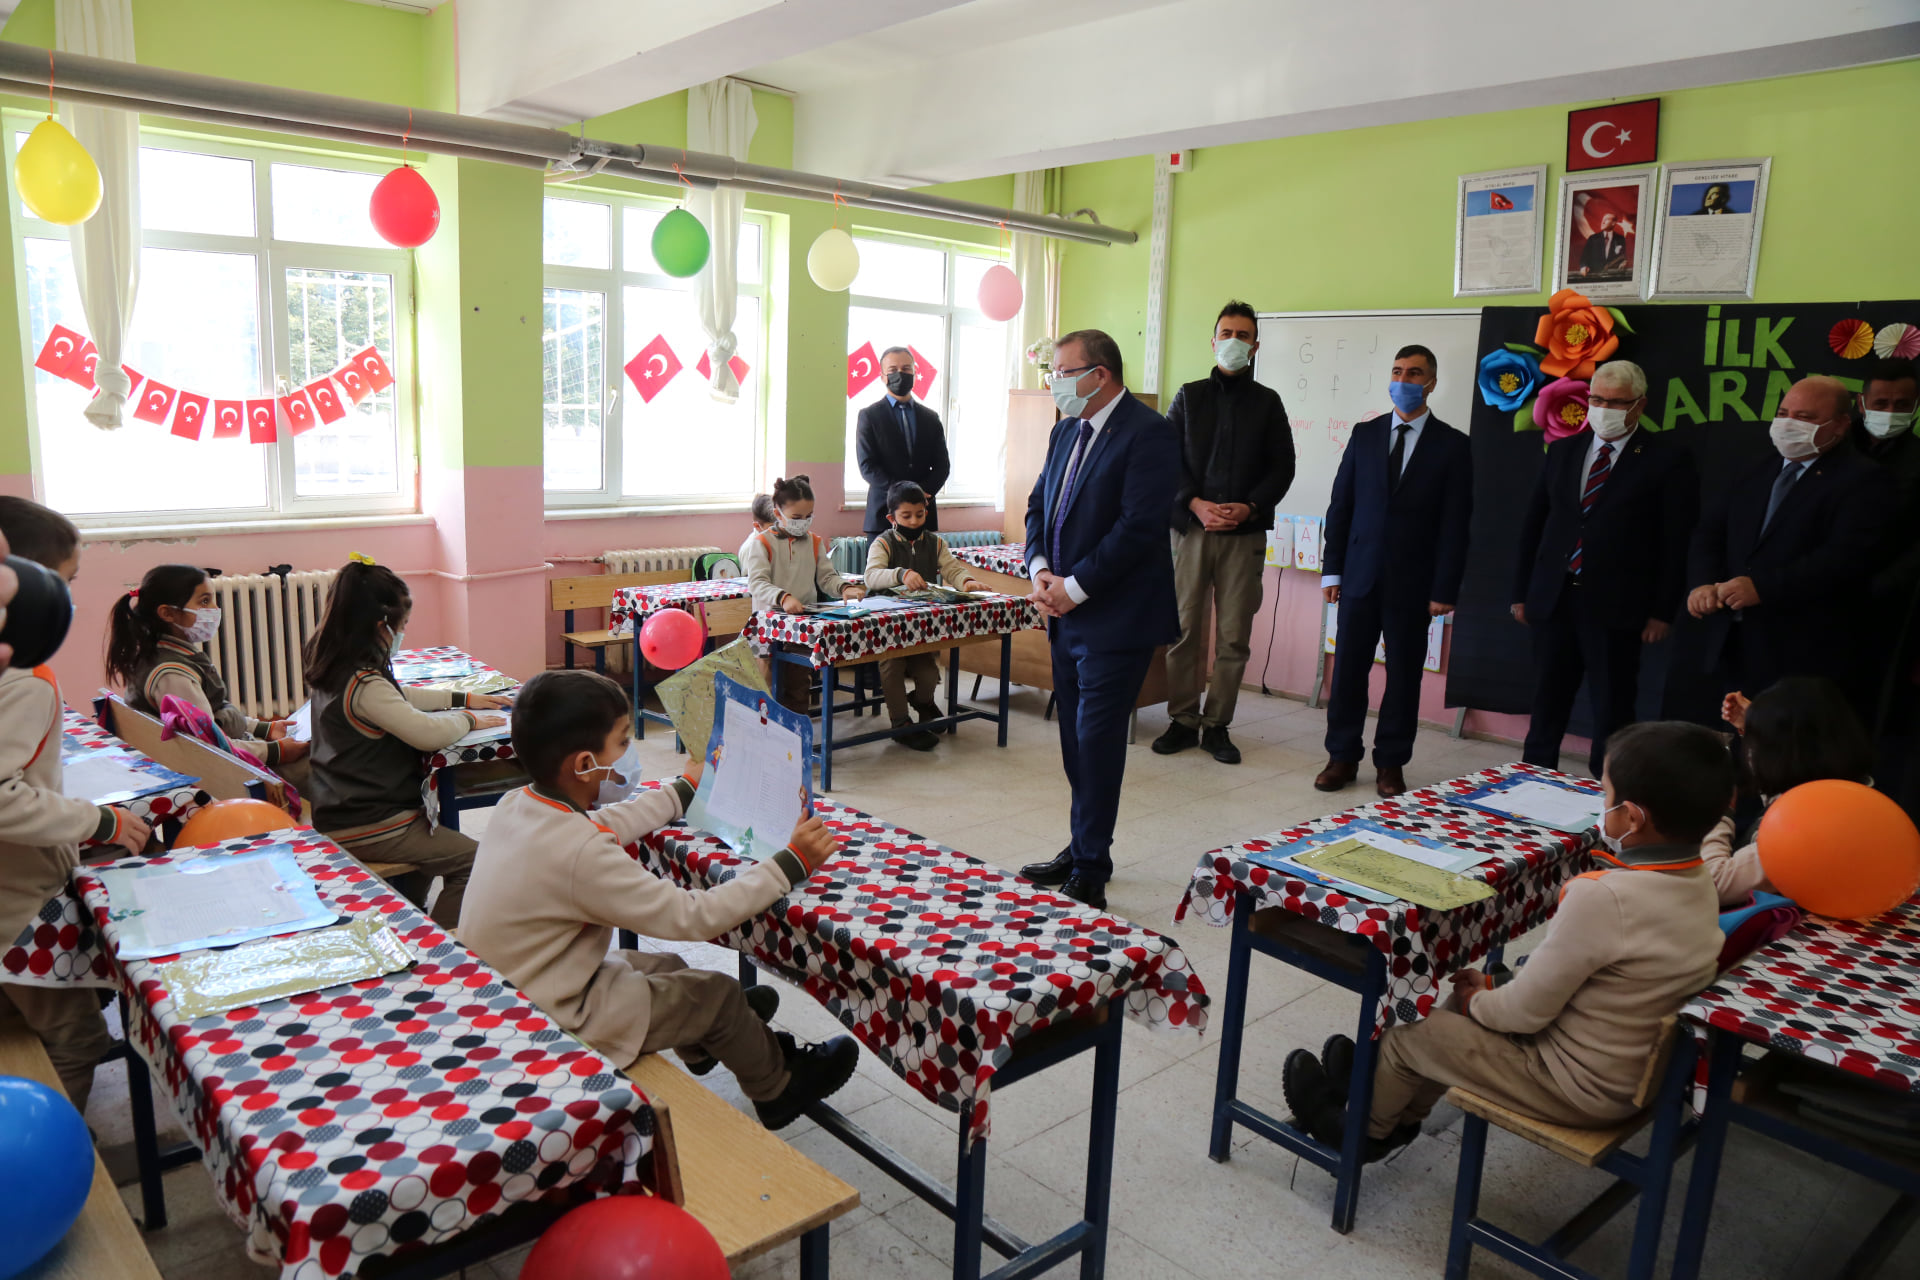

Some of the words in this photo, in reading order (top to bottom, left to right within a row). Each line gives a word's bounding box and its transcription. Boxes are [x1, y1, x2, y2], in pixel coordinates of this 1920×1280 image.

[1299, 335, 1314, 364] Ğ
[1336, 338, 1347, 361] F
[1368, 333, 1379, 354] J
[1704, 305, 1796, 369] İLK
[1330, 373, 1340, 400] f
[1327, 416, 1350, 441] fare
[1275, 522, 1285, 540] L
[1301, 527, 1312, 543] A
[1308, 554, 1316, 565] a
[1428, 648, 1437, 667] h
